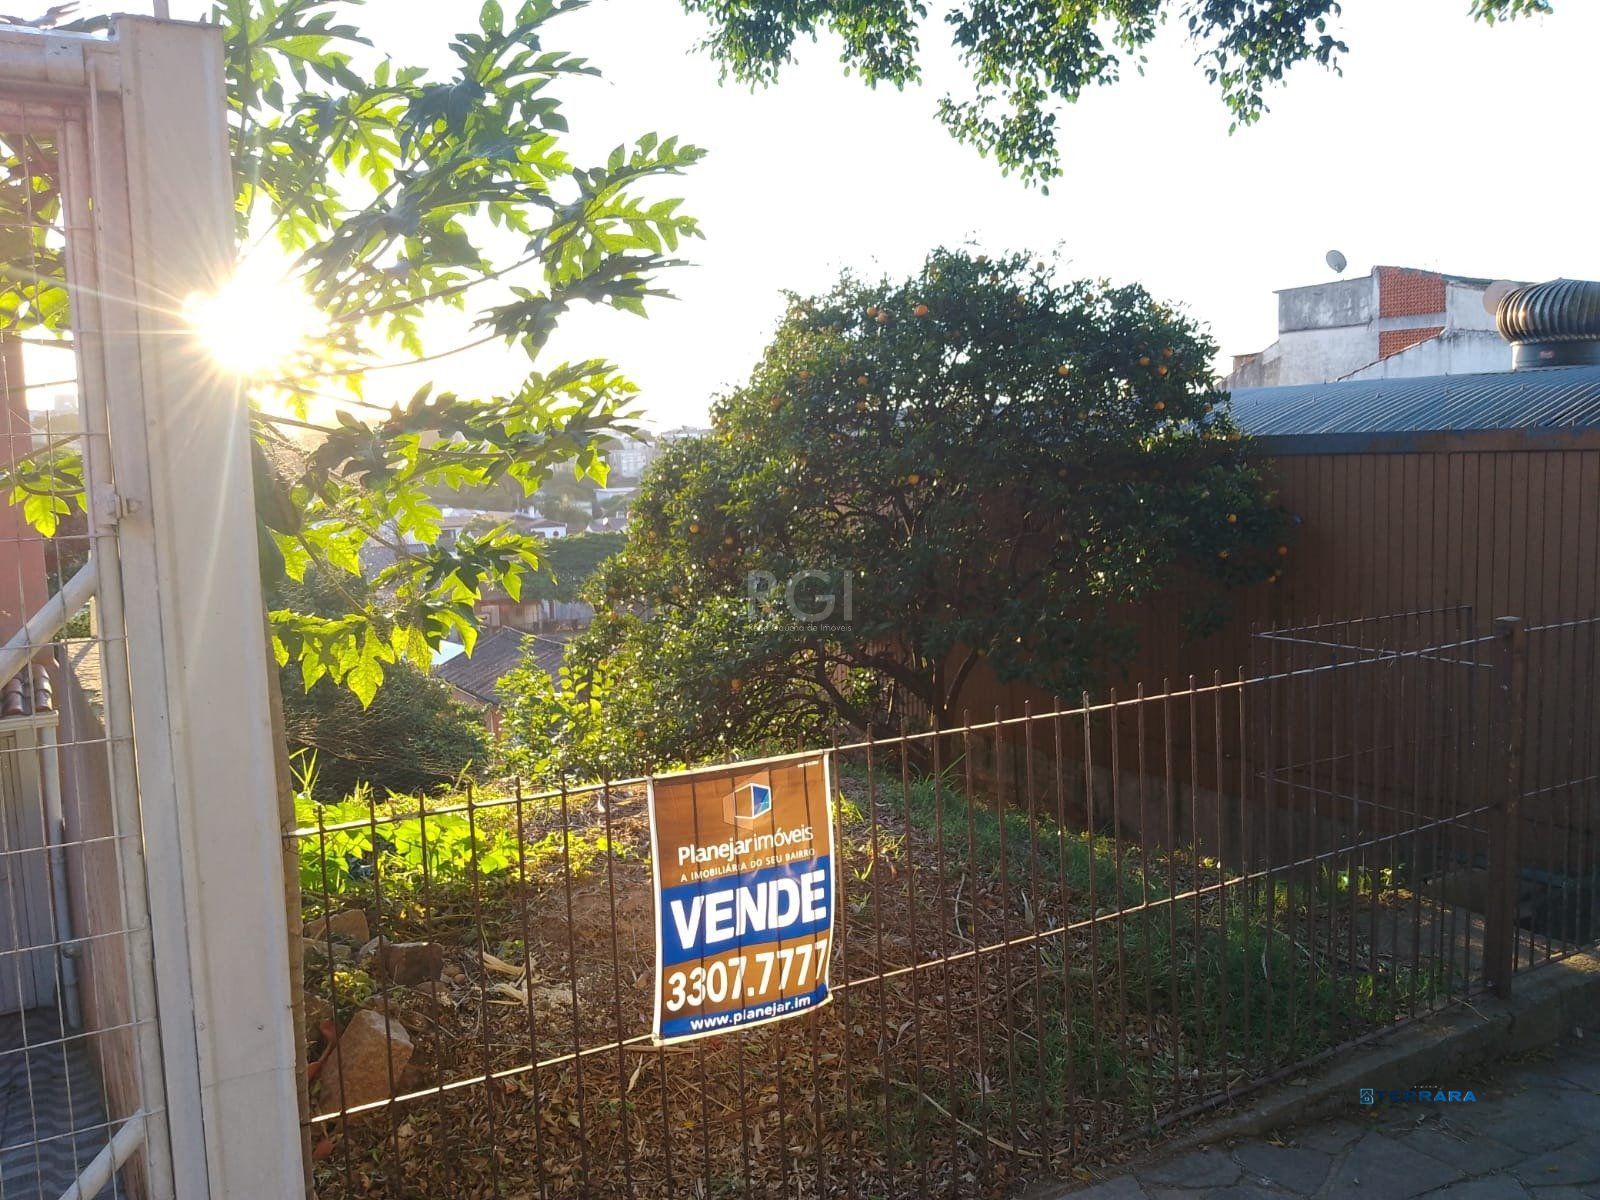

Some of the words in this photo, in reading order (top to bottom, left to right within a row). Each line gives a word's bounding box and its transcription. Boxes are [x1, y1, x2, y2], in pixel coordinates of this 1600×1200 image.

[680, 873, 688, 883] A
[750, 858, 763, 868] DO
[766, 854, 783, 866] SEU
[785, 848, 815, 863] BAIRRO
[670, 869, 827, 950] VENDE
[666, 938, 828, 1012] 3307.7777
[690, 995, 811, 1031] www.planejar.im
